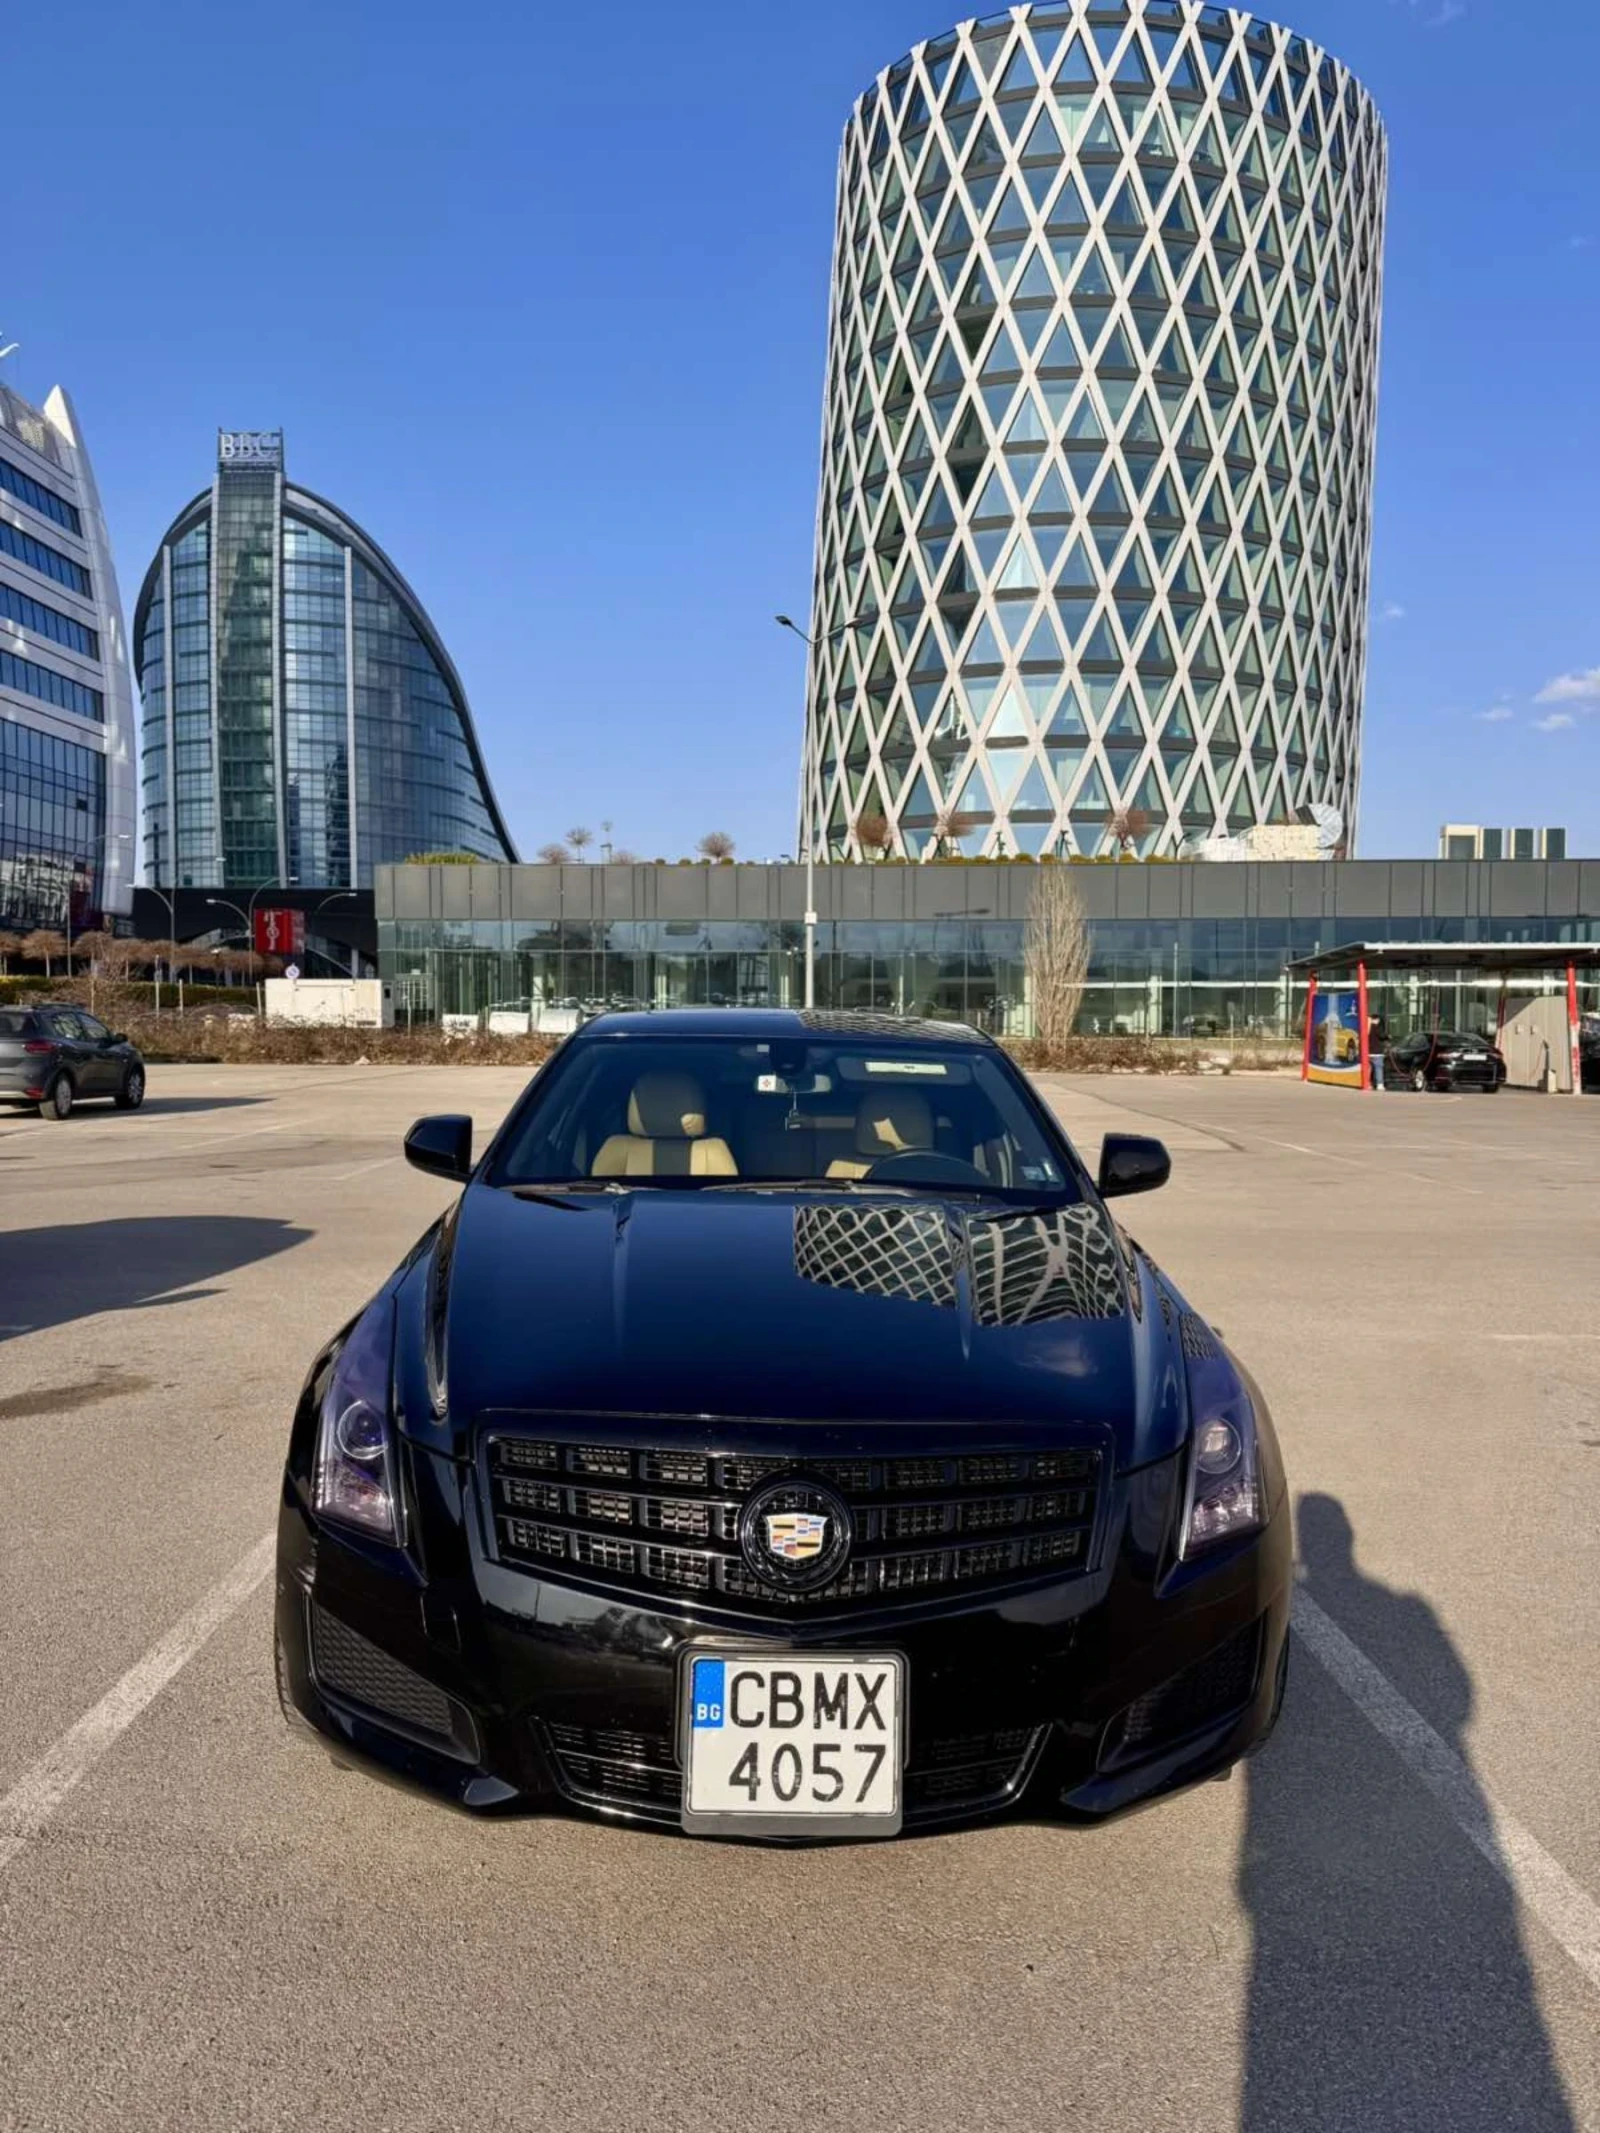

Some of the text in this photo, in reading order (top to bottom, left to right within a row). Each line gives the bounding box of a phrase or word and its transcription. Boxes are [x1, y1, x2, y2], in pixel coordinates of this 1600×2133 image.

[696, 1703, 721, 1721] BG
[730, 1671, 887, 1730] CBMX
[729, 1742, 886, 1803] 4057
